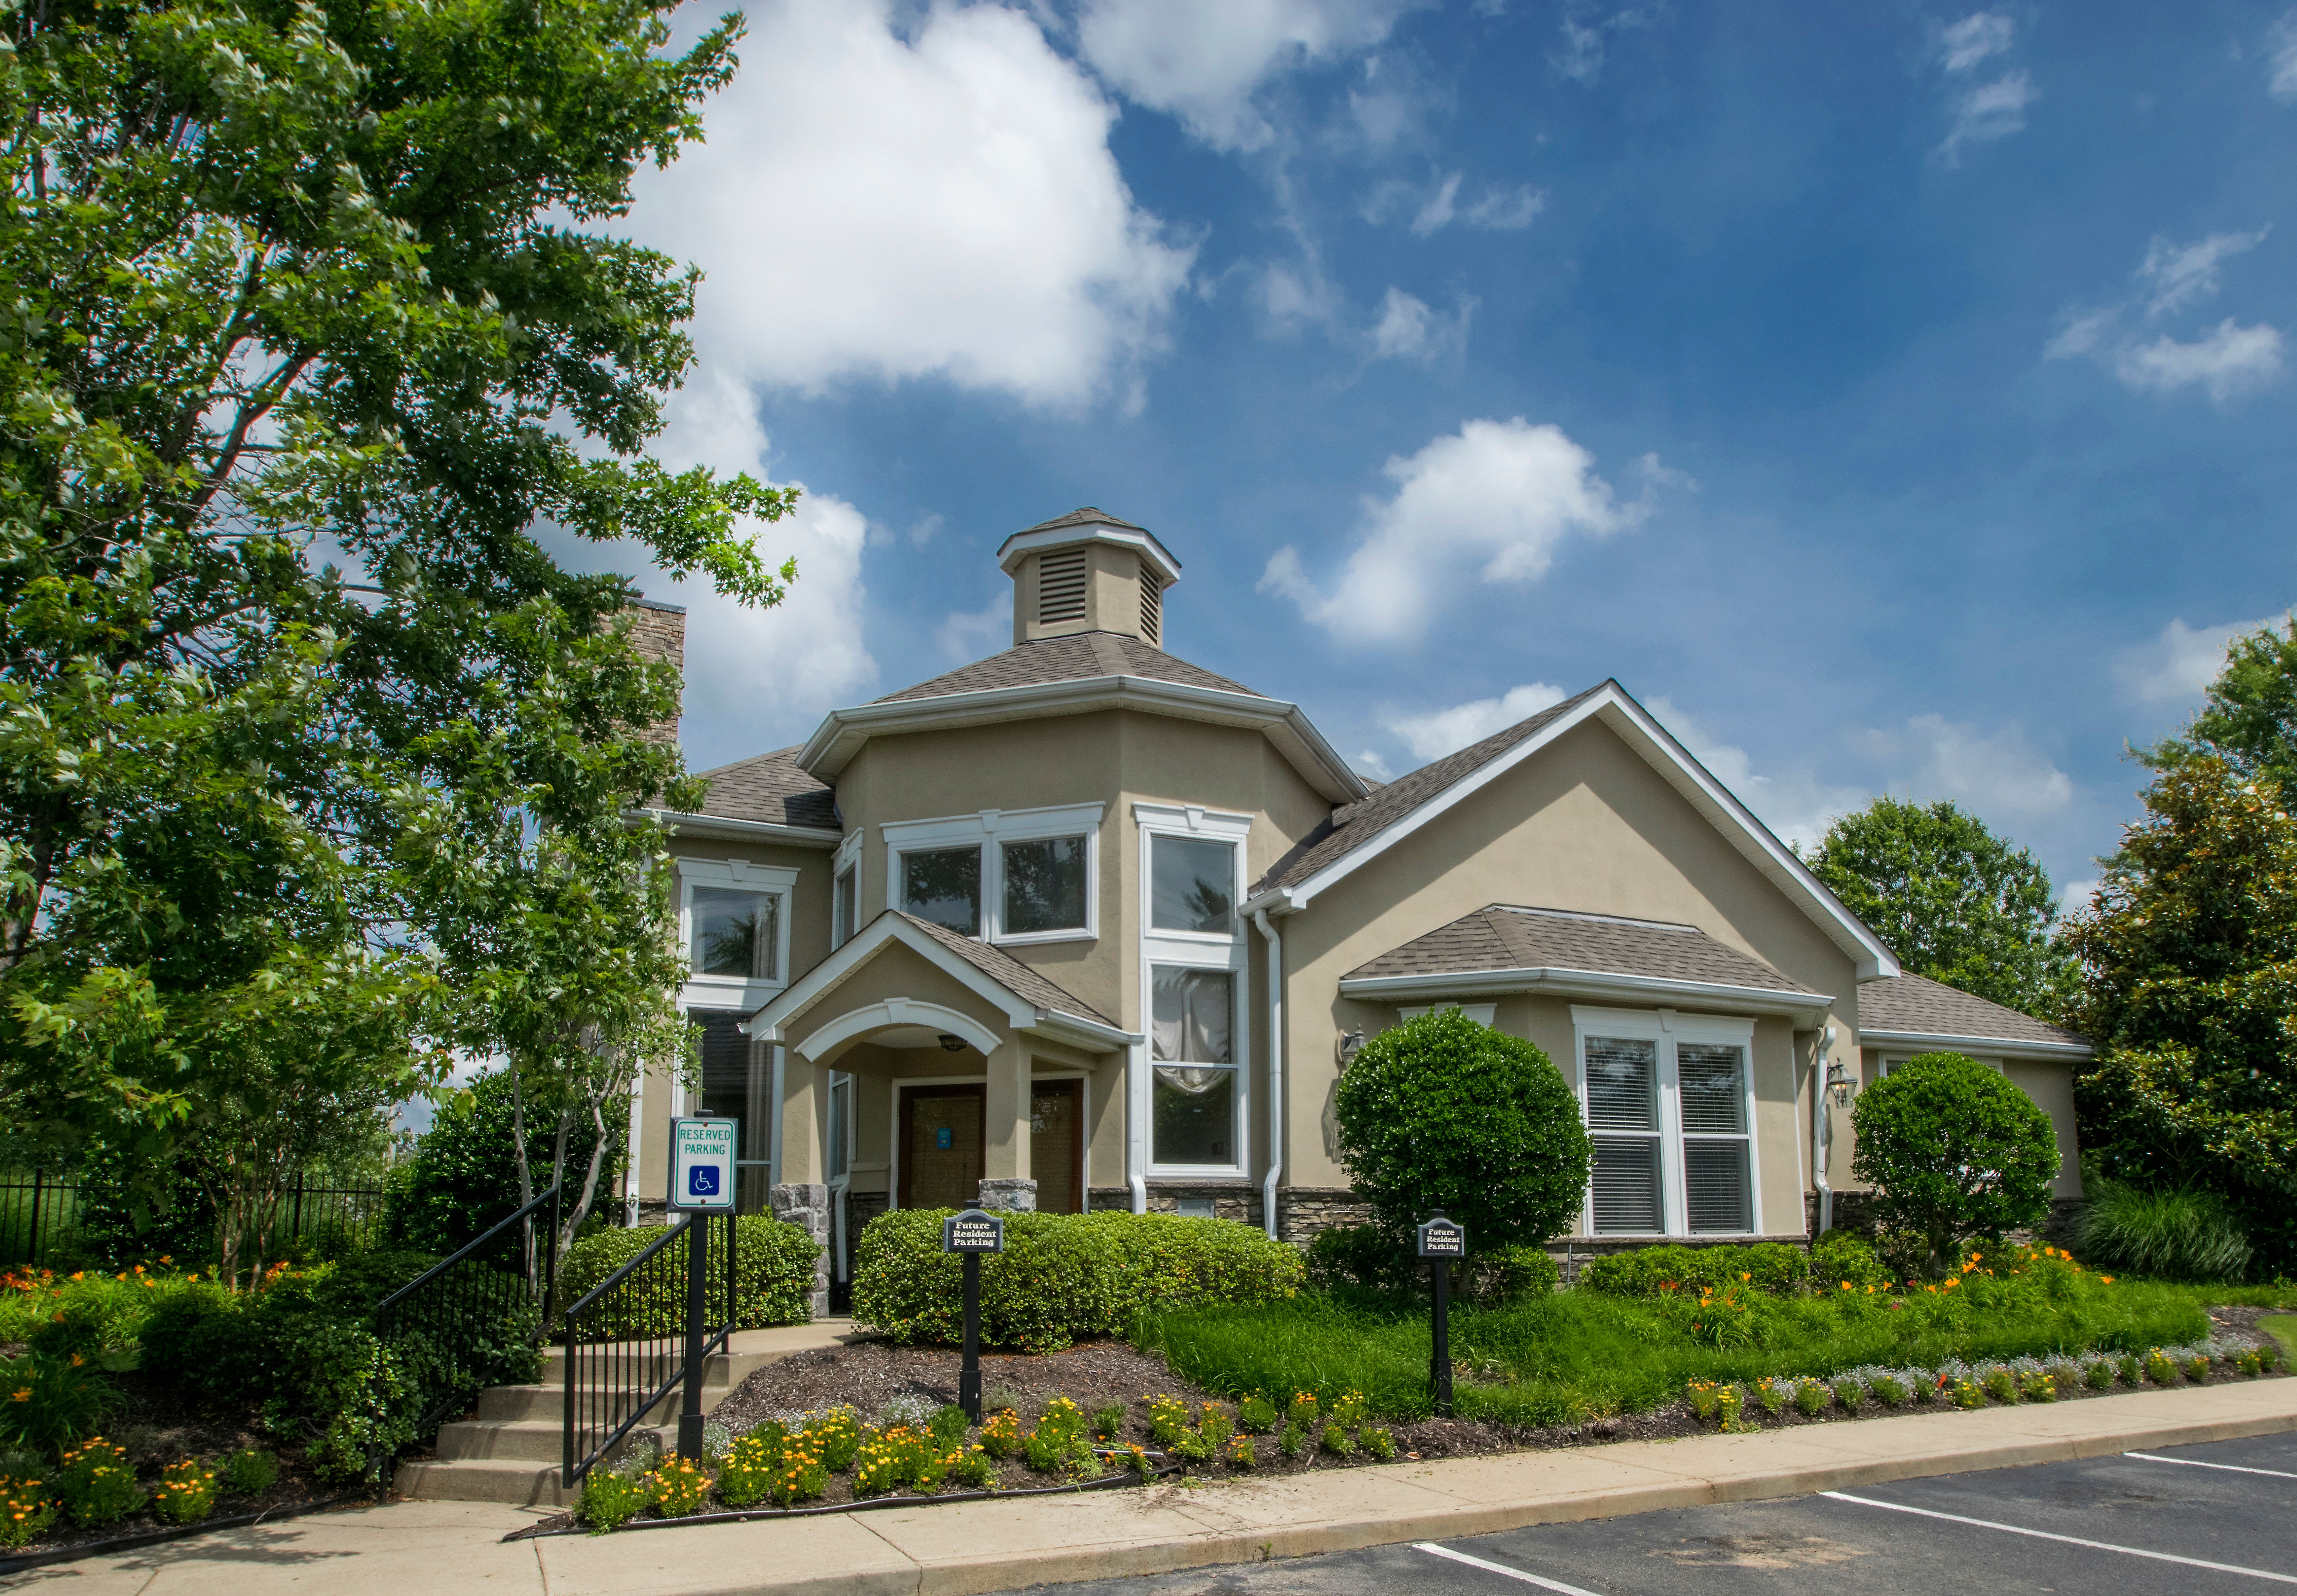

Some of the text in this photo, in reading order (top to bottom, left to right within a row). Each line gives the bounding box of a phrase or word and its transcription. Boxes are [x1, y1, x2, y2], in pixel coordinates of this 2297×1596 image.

[680, 1129, 730, 1140] RESERVED
[685, 1144, 725, 1155] PARKING
[954, 1238, 994, 1247] Parking
